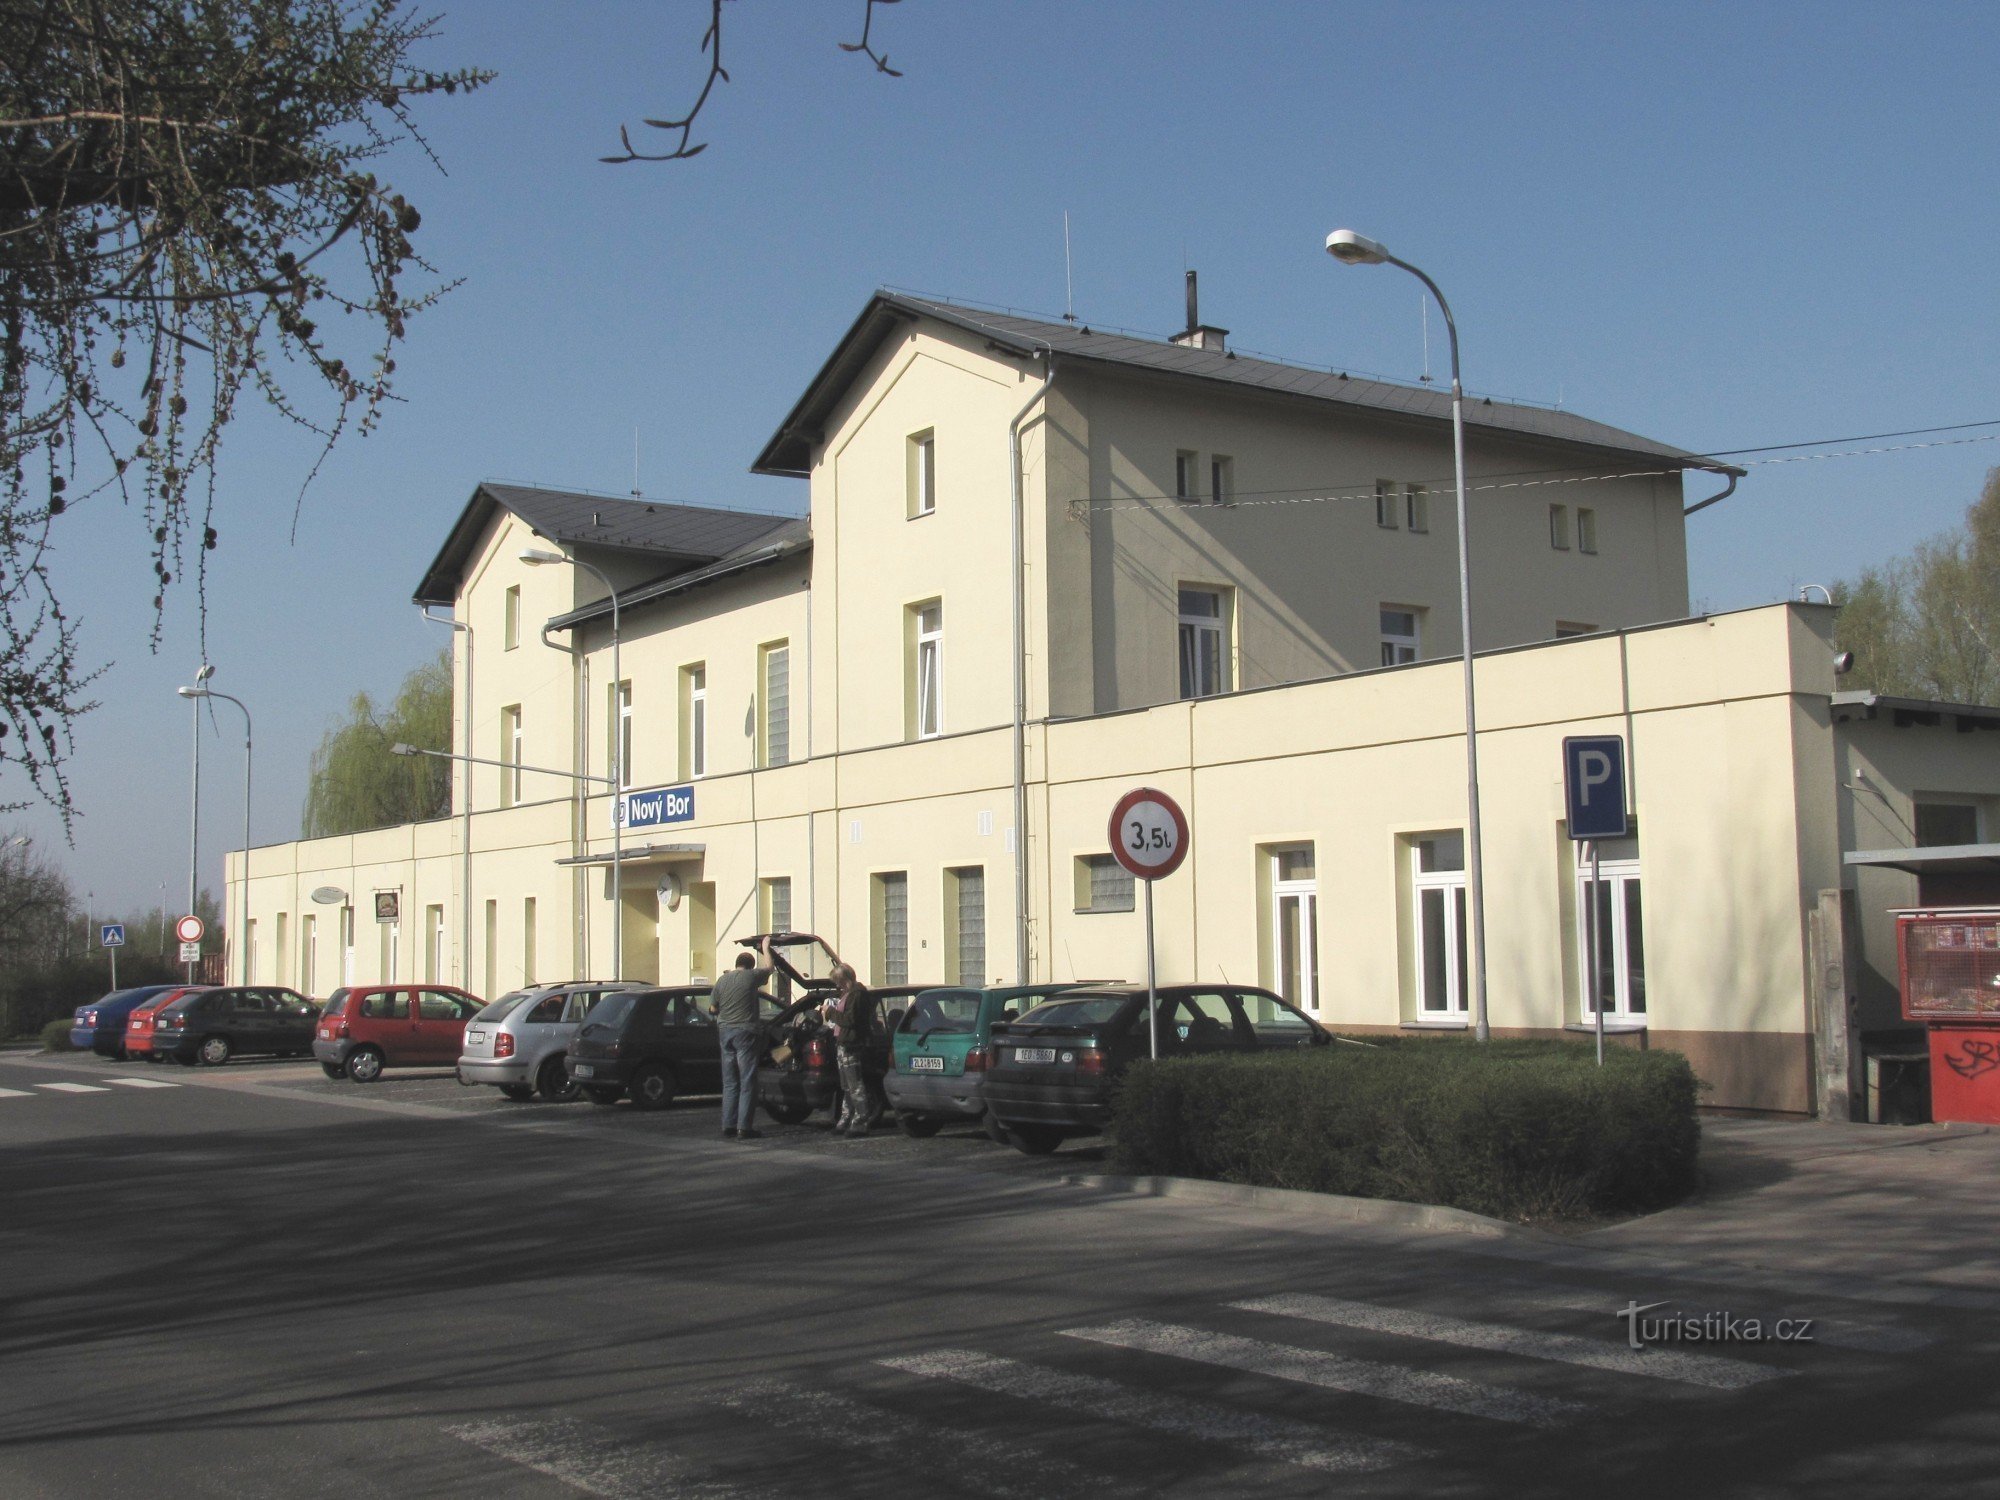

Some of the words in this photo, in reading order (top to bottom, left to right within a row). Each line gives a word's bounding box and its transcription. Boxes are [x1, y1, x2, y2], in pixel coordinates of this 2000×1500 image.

[1579, 751, 1611, 806] P
[632, 795, 662, 823] Nový
[667, 794, 690, 816] Bor
[1130, 821, 1172, 852] 3,5t
